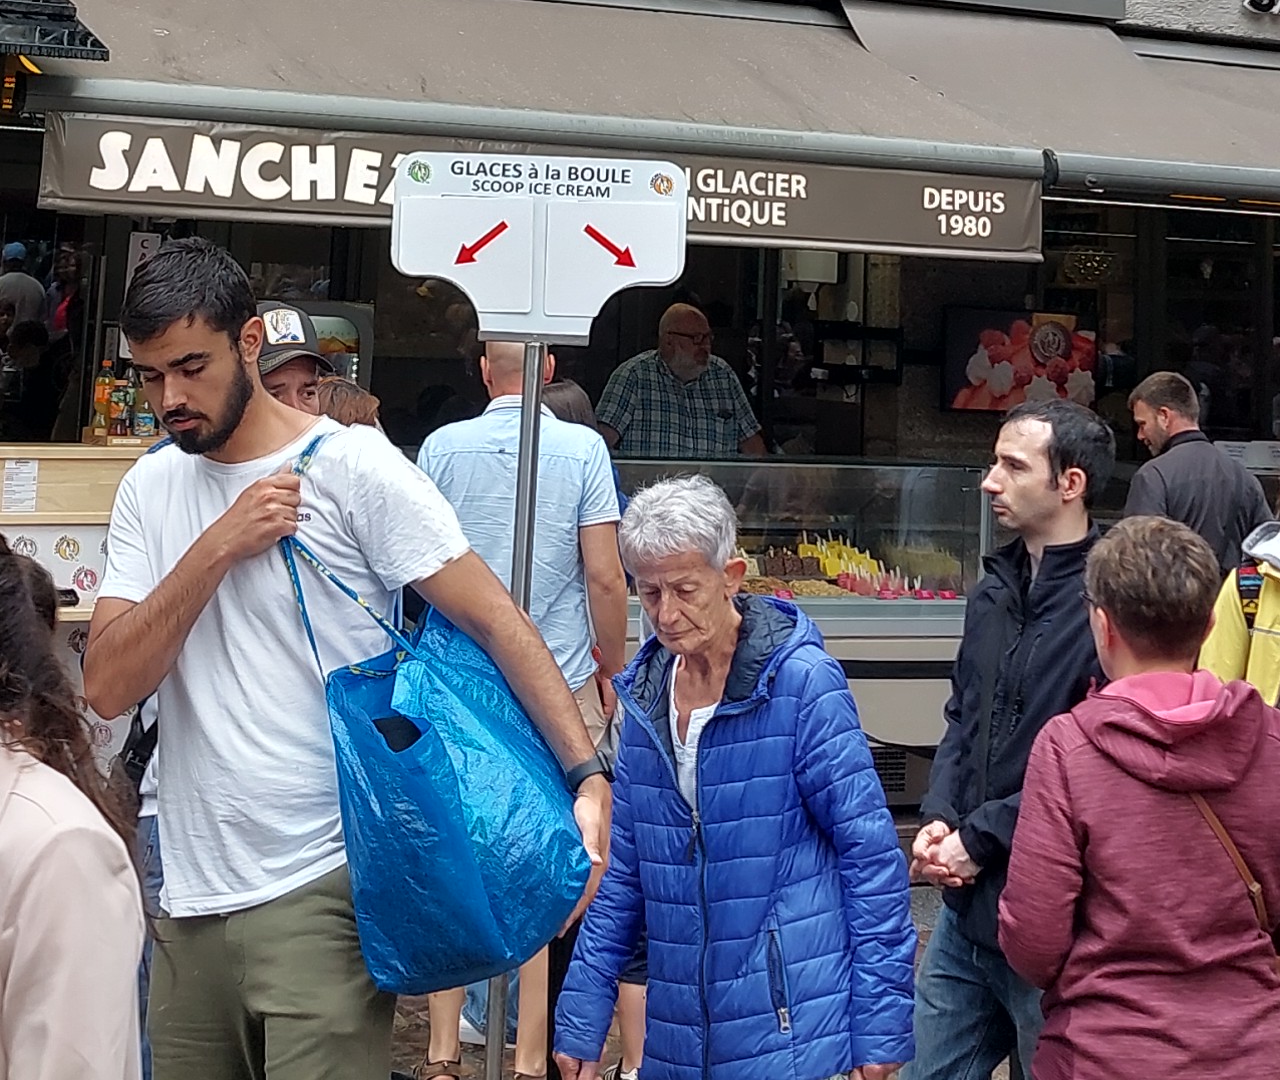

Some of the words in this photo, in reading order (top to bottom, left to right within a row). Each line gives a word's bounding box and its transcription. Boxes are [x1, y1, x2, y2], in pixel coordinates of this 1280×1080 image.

[451, 161, 522, 179] GLACES
[528, 163, 538, 179] à
[545, 164, 560, 181] la
[570, 167, 631, 184] BOULE
[472, 180, 524, 194] SCOOP
[529, 182, 551, 195] ICE
[556, 185, 610, 198] CREAM
[937, 214, 992, 237] 1980
